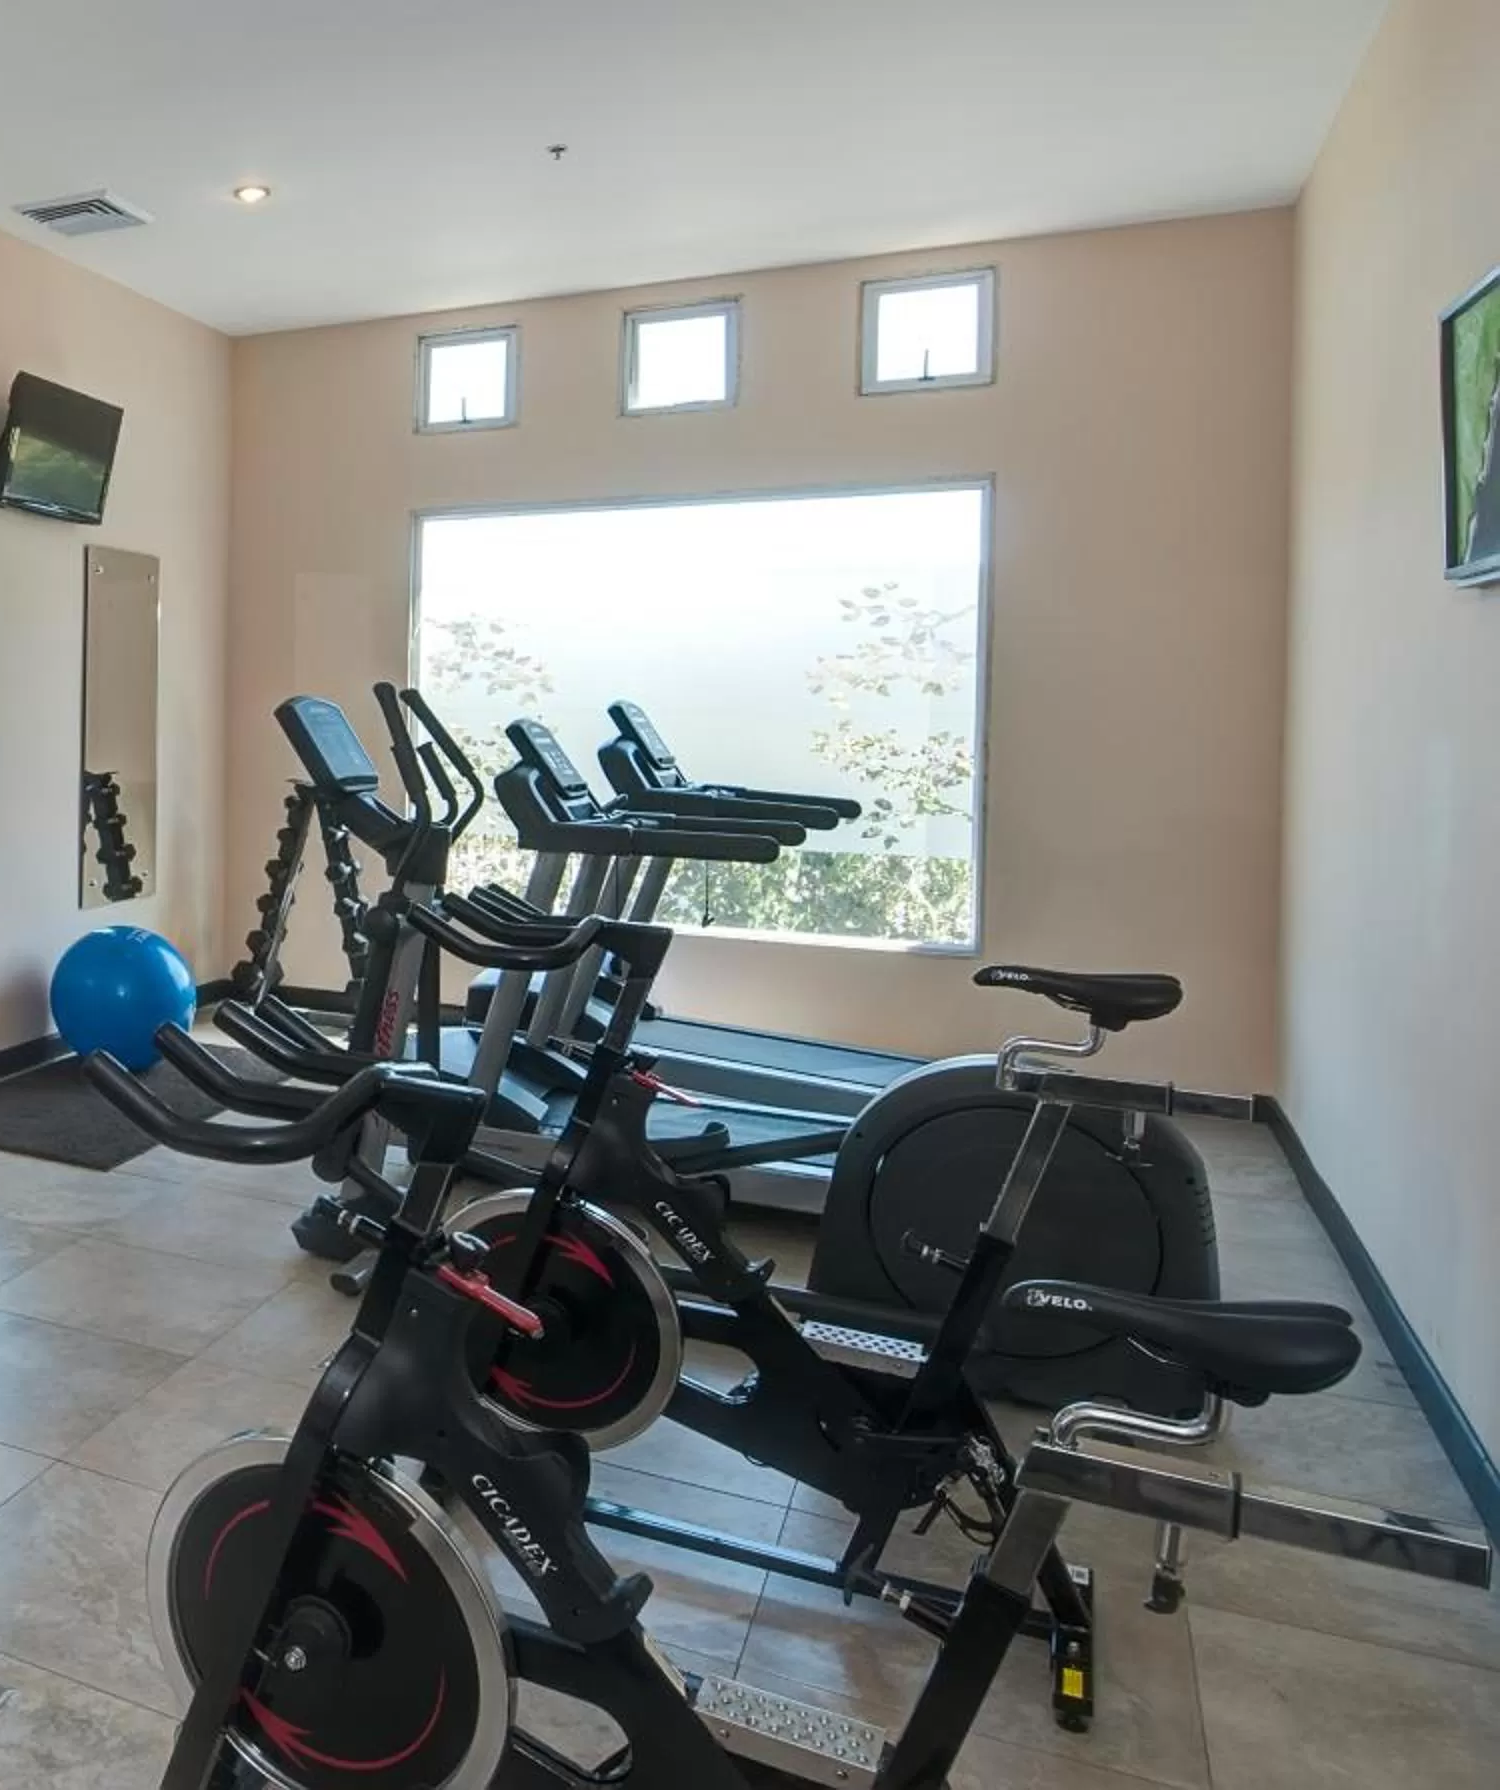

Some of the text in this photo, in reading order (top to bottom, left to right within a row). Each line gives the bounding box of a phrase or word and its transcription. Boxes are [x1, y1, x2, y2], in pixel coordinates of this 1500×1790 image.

[655, 1201, 716, 1262] CICADEX
[1039, 1291, 1088, 1311] VELO
[472, 1475, 558, 1574] CICADEX
